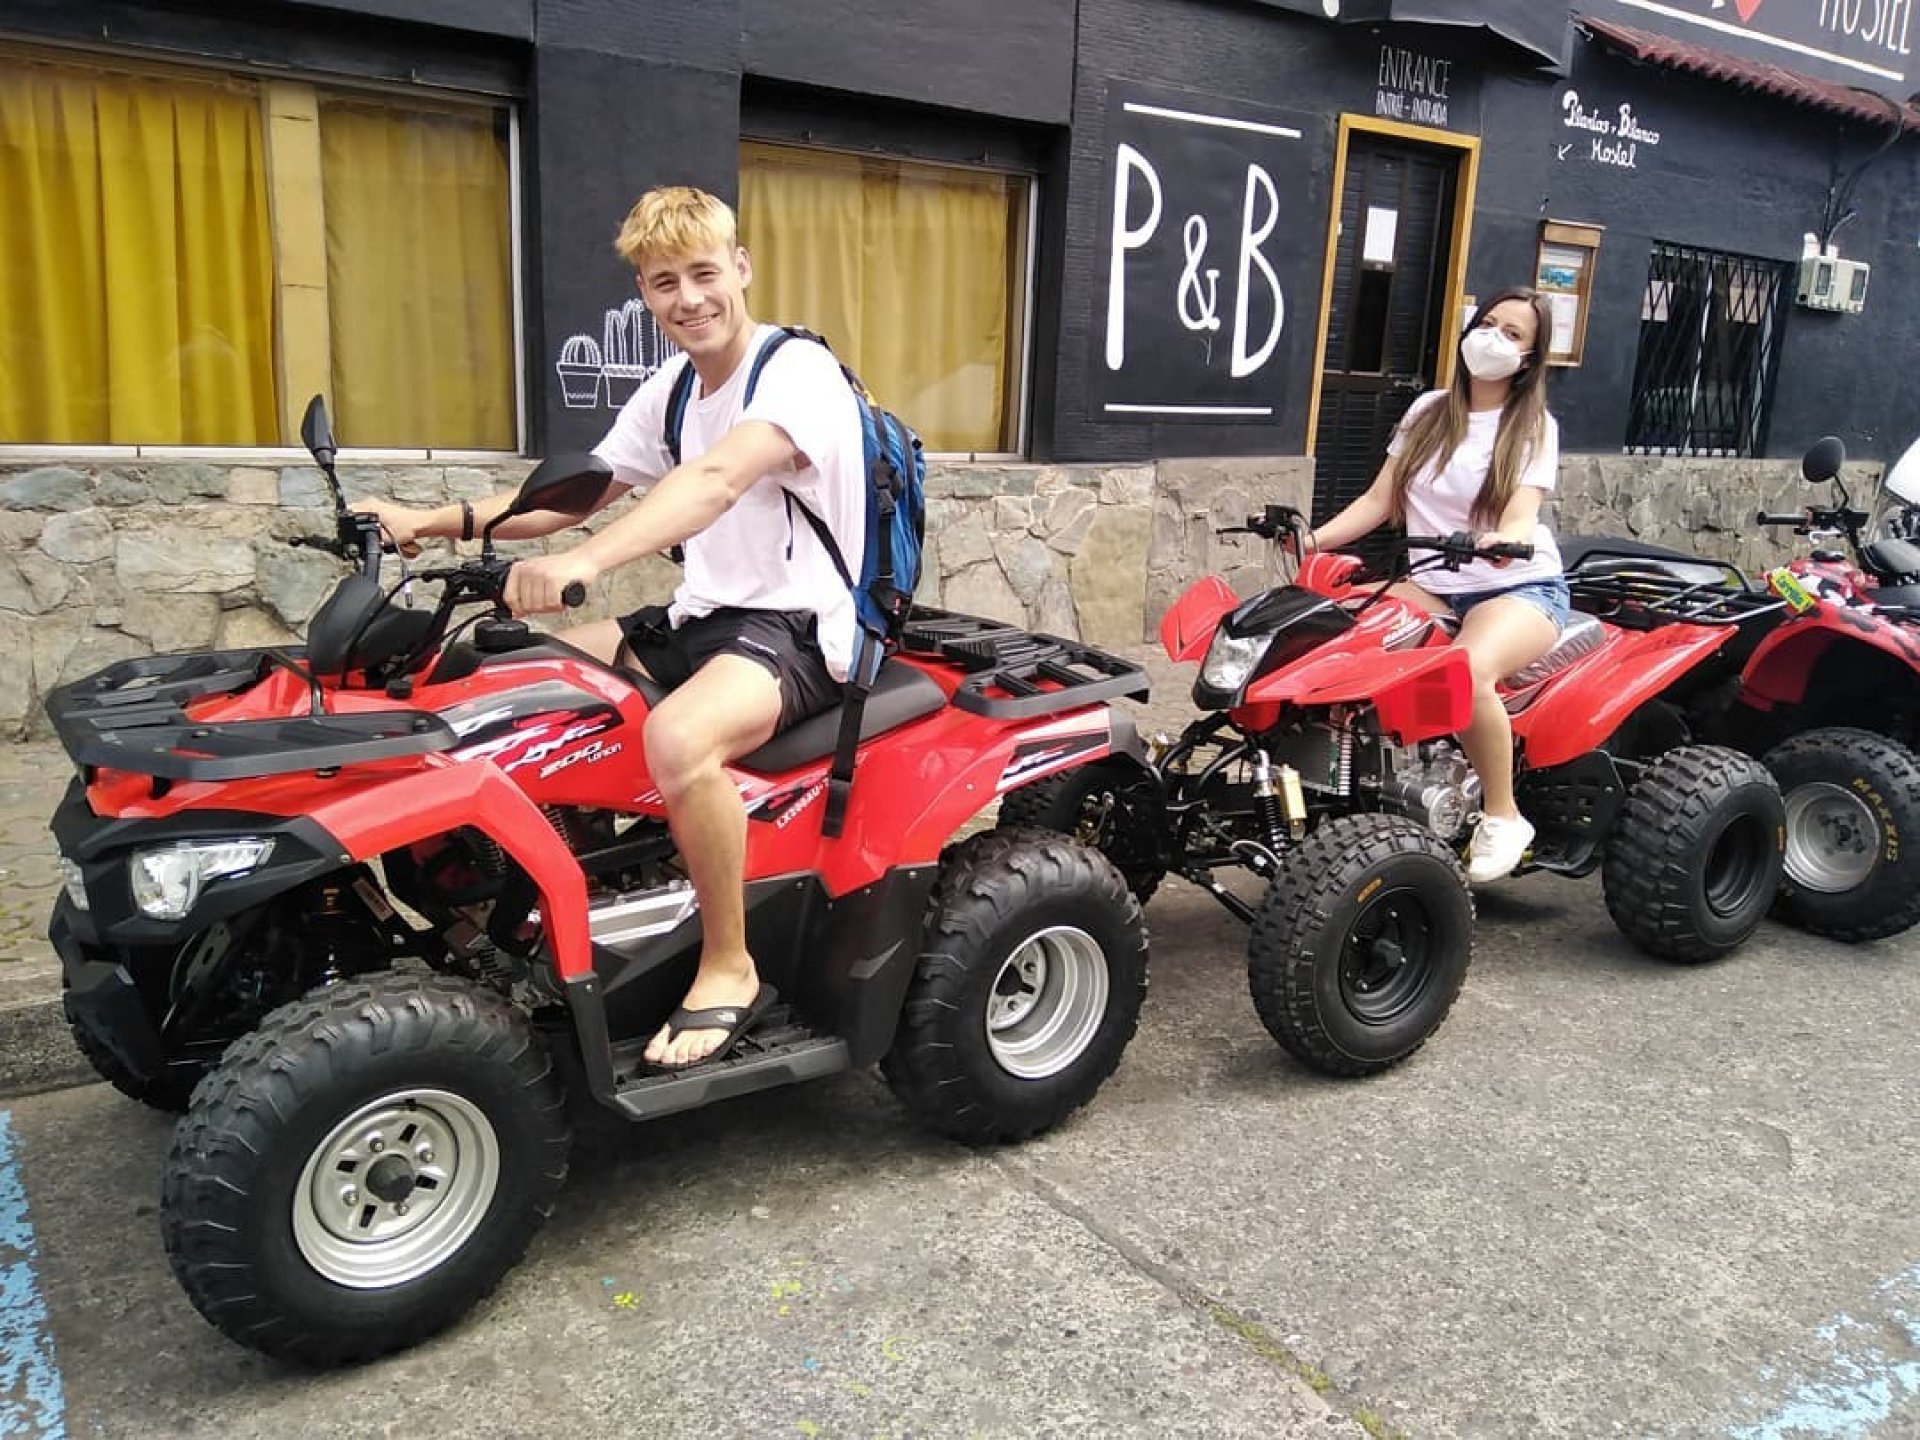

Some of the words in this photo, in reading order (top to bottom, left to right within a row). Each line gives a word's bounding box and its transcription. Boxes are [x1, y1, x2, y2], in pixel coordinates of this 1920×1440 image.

[1379, 45, 1451, 98] ENTRANCE
[1617, 102, 1660, 144] Blanco
[1591, 138, 1637, 168] Hostel
[1105, 143, 1162, 370] P
[1177, 213, 1221, 330] &
[1231, 163, 1284, 378] B
[1852, 777, 1898, 862] MAXXIS
